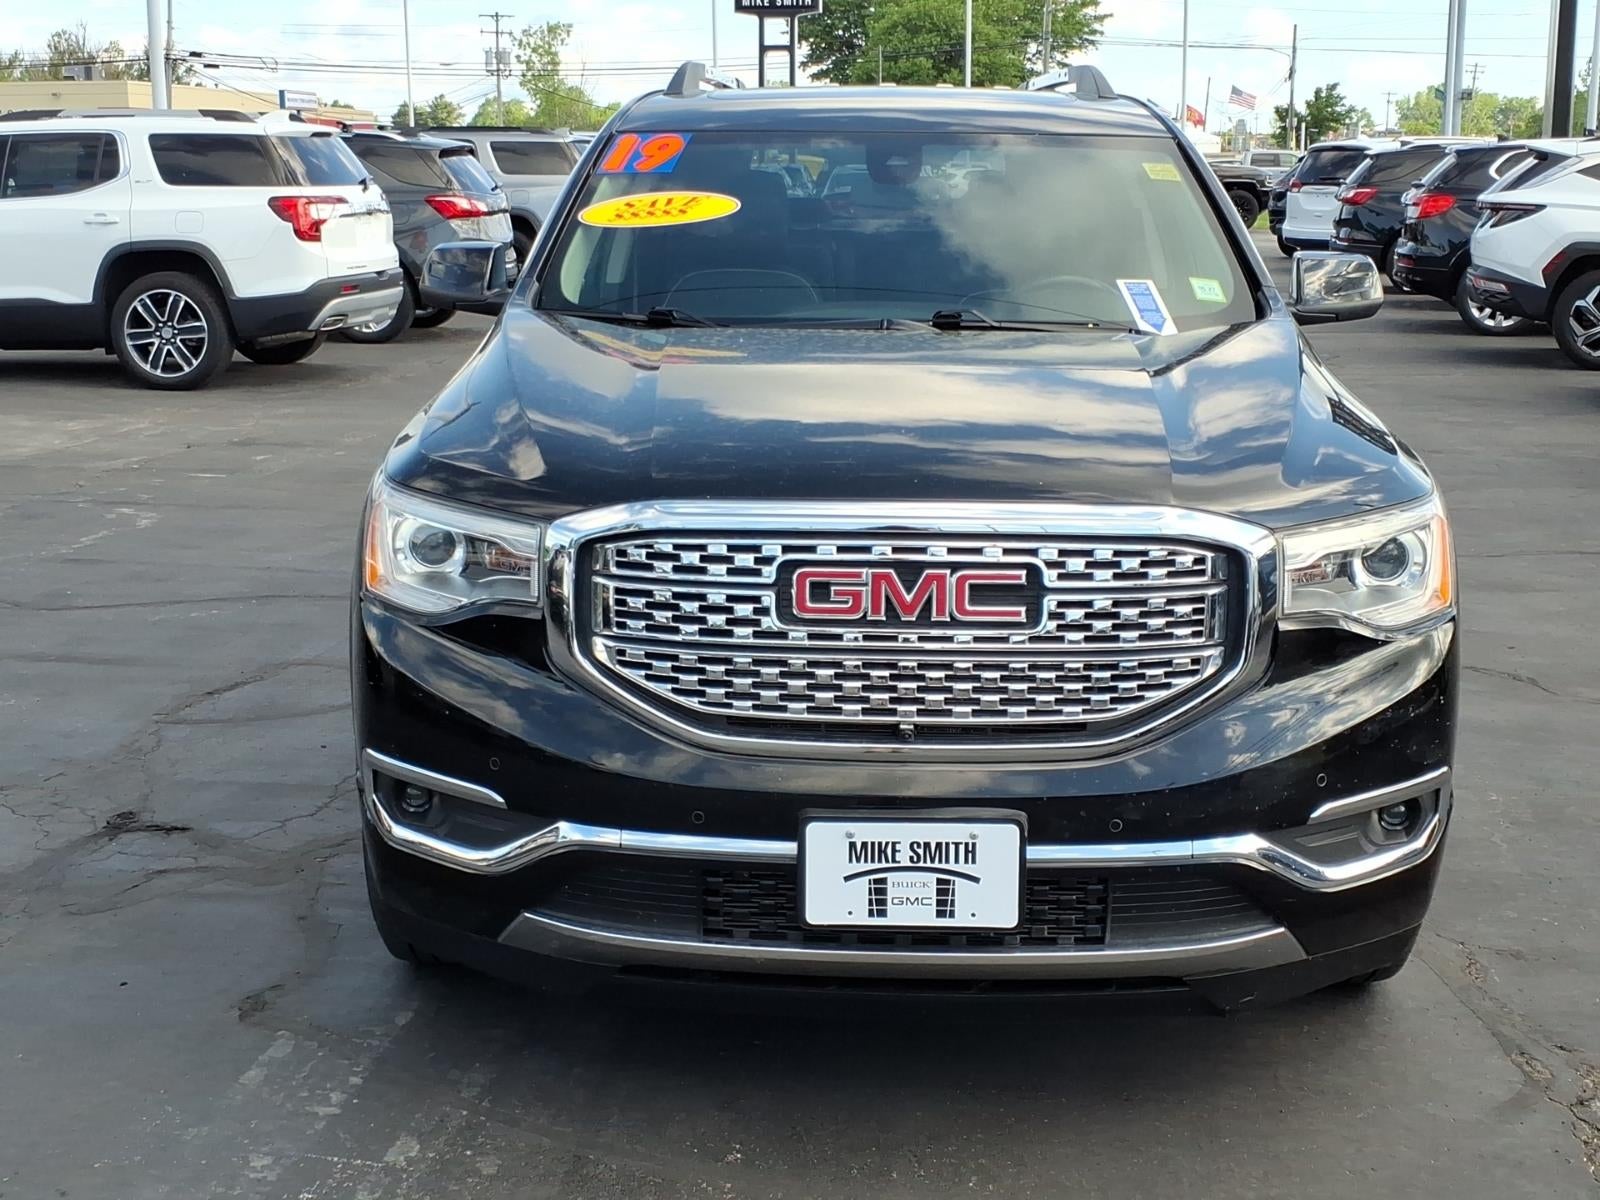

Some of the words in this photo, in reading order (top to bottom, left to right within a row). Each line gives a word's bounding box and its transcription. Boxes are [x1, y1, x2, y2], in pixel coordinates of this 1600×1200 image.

[601, 133, 685, 173] 19
[792, 568, 1027, 622] GMC
[848, 840, 902, 864] MIKE
[909, 840, 977, 865] SMITH
[892, 881, 931, 889] BUICK
[891, 896, 933, 906] GMC
